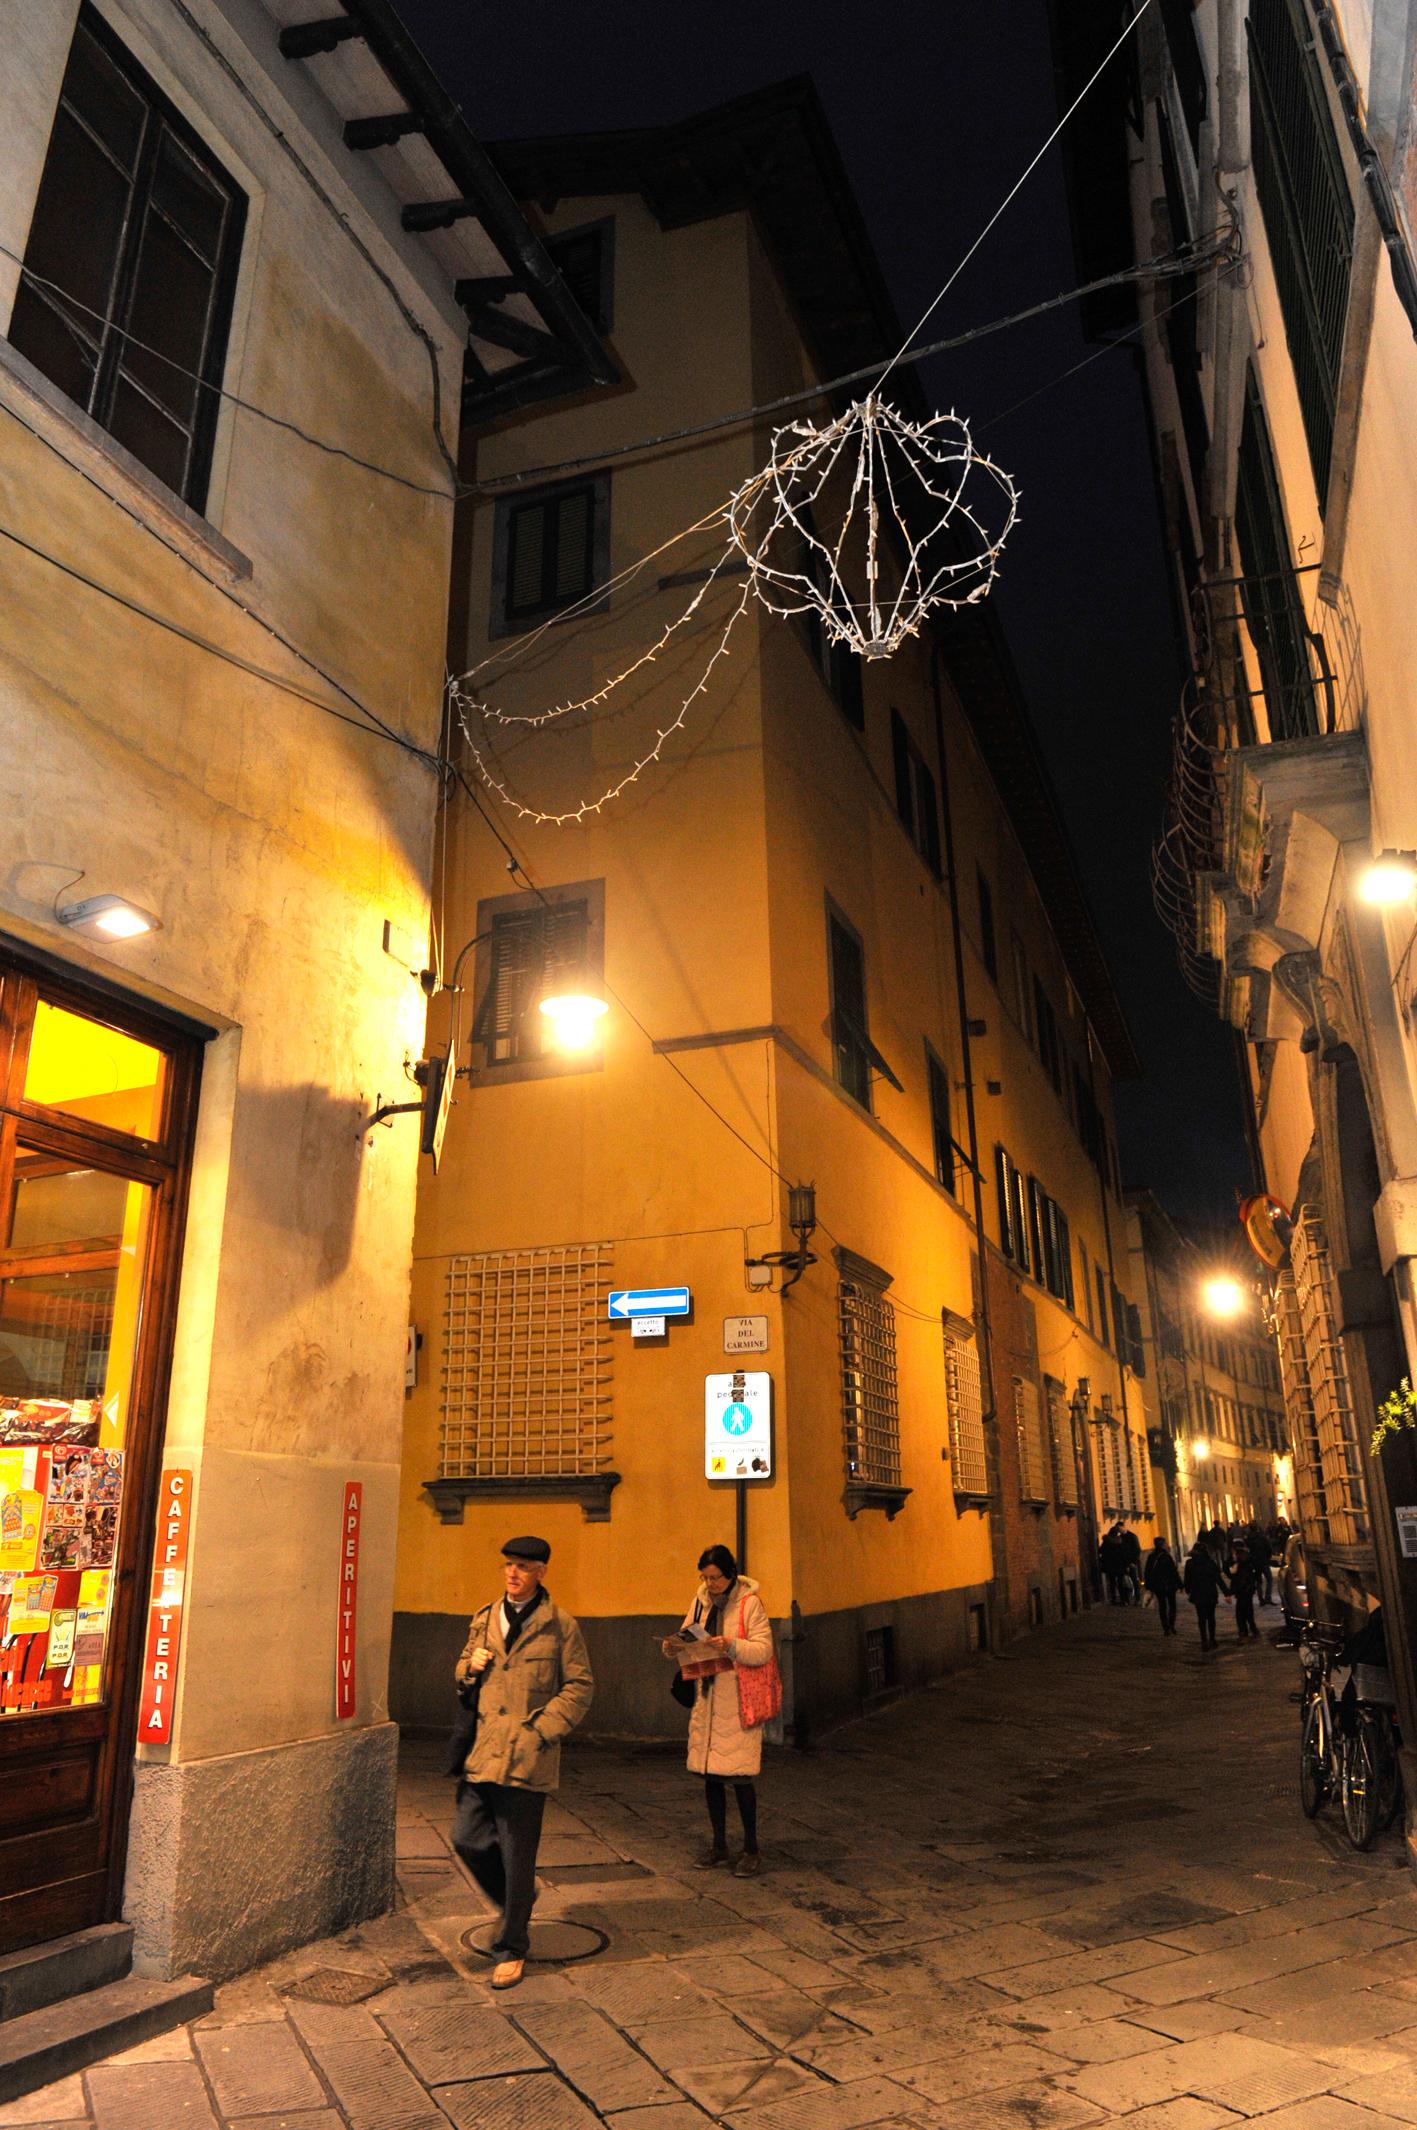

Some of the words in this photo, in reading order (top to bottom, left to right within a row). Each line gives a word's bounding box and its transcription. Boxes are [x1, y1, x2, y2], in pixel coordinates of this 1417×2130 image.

[726, 1341, 765, 1349] CARMINE
[148, 1477, 184, 1728] CAFFETERIA
[341, 1492, 358, 1703] APERITIVI
